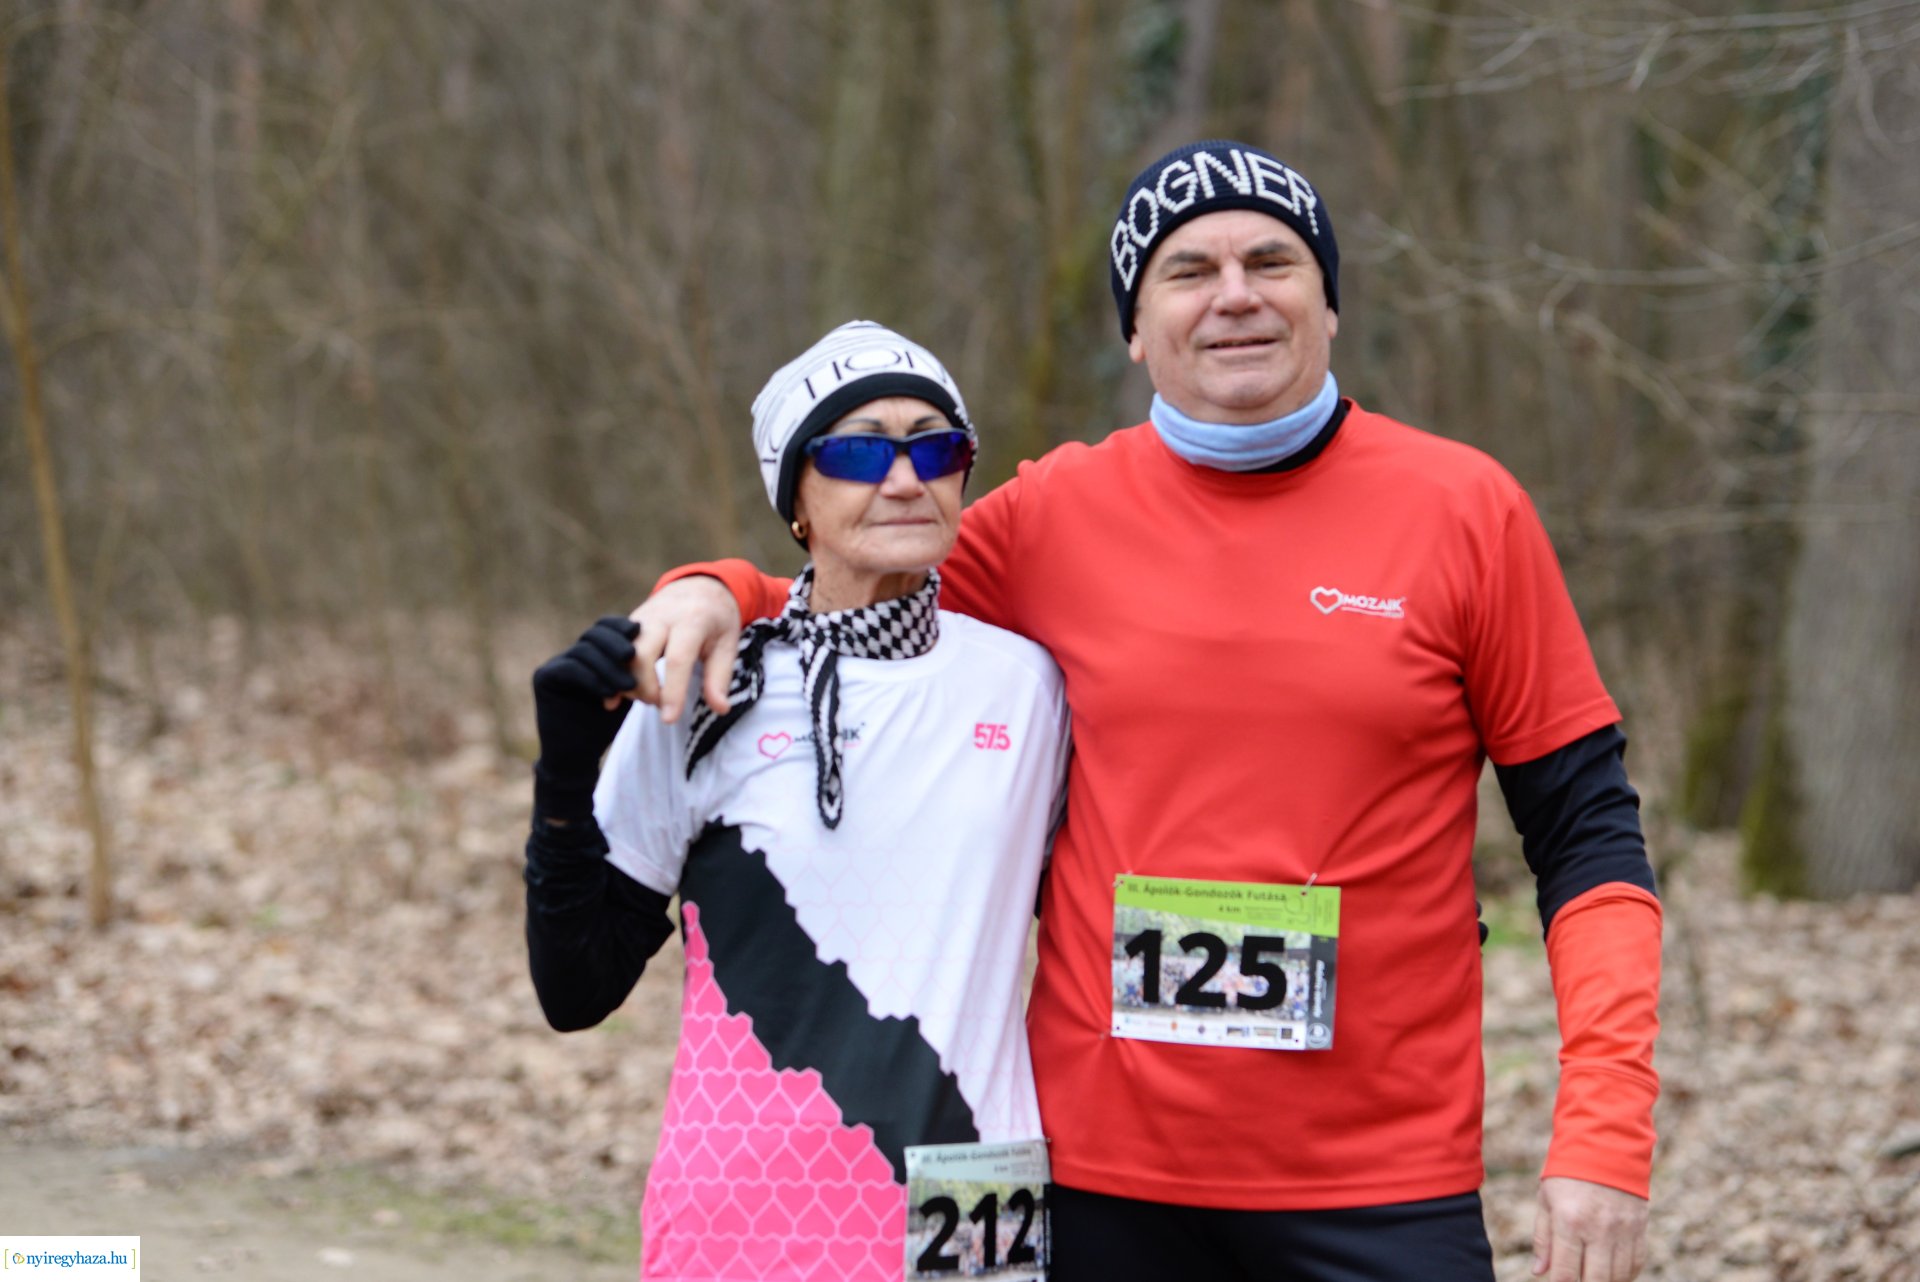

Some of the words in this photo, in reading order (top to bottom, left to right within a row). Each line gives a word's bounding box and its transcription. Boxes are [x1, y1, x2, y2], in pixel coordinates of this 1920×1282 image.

[1110, 149, 1319, 291] BOGNER
[1125, 929, 1287, 1011] 125
[917, 1188, 1035, 1271] 212
